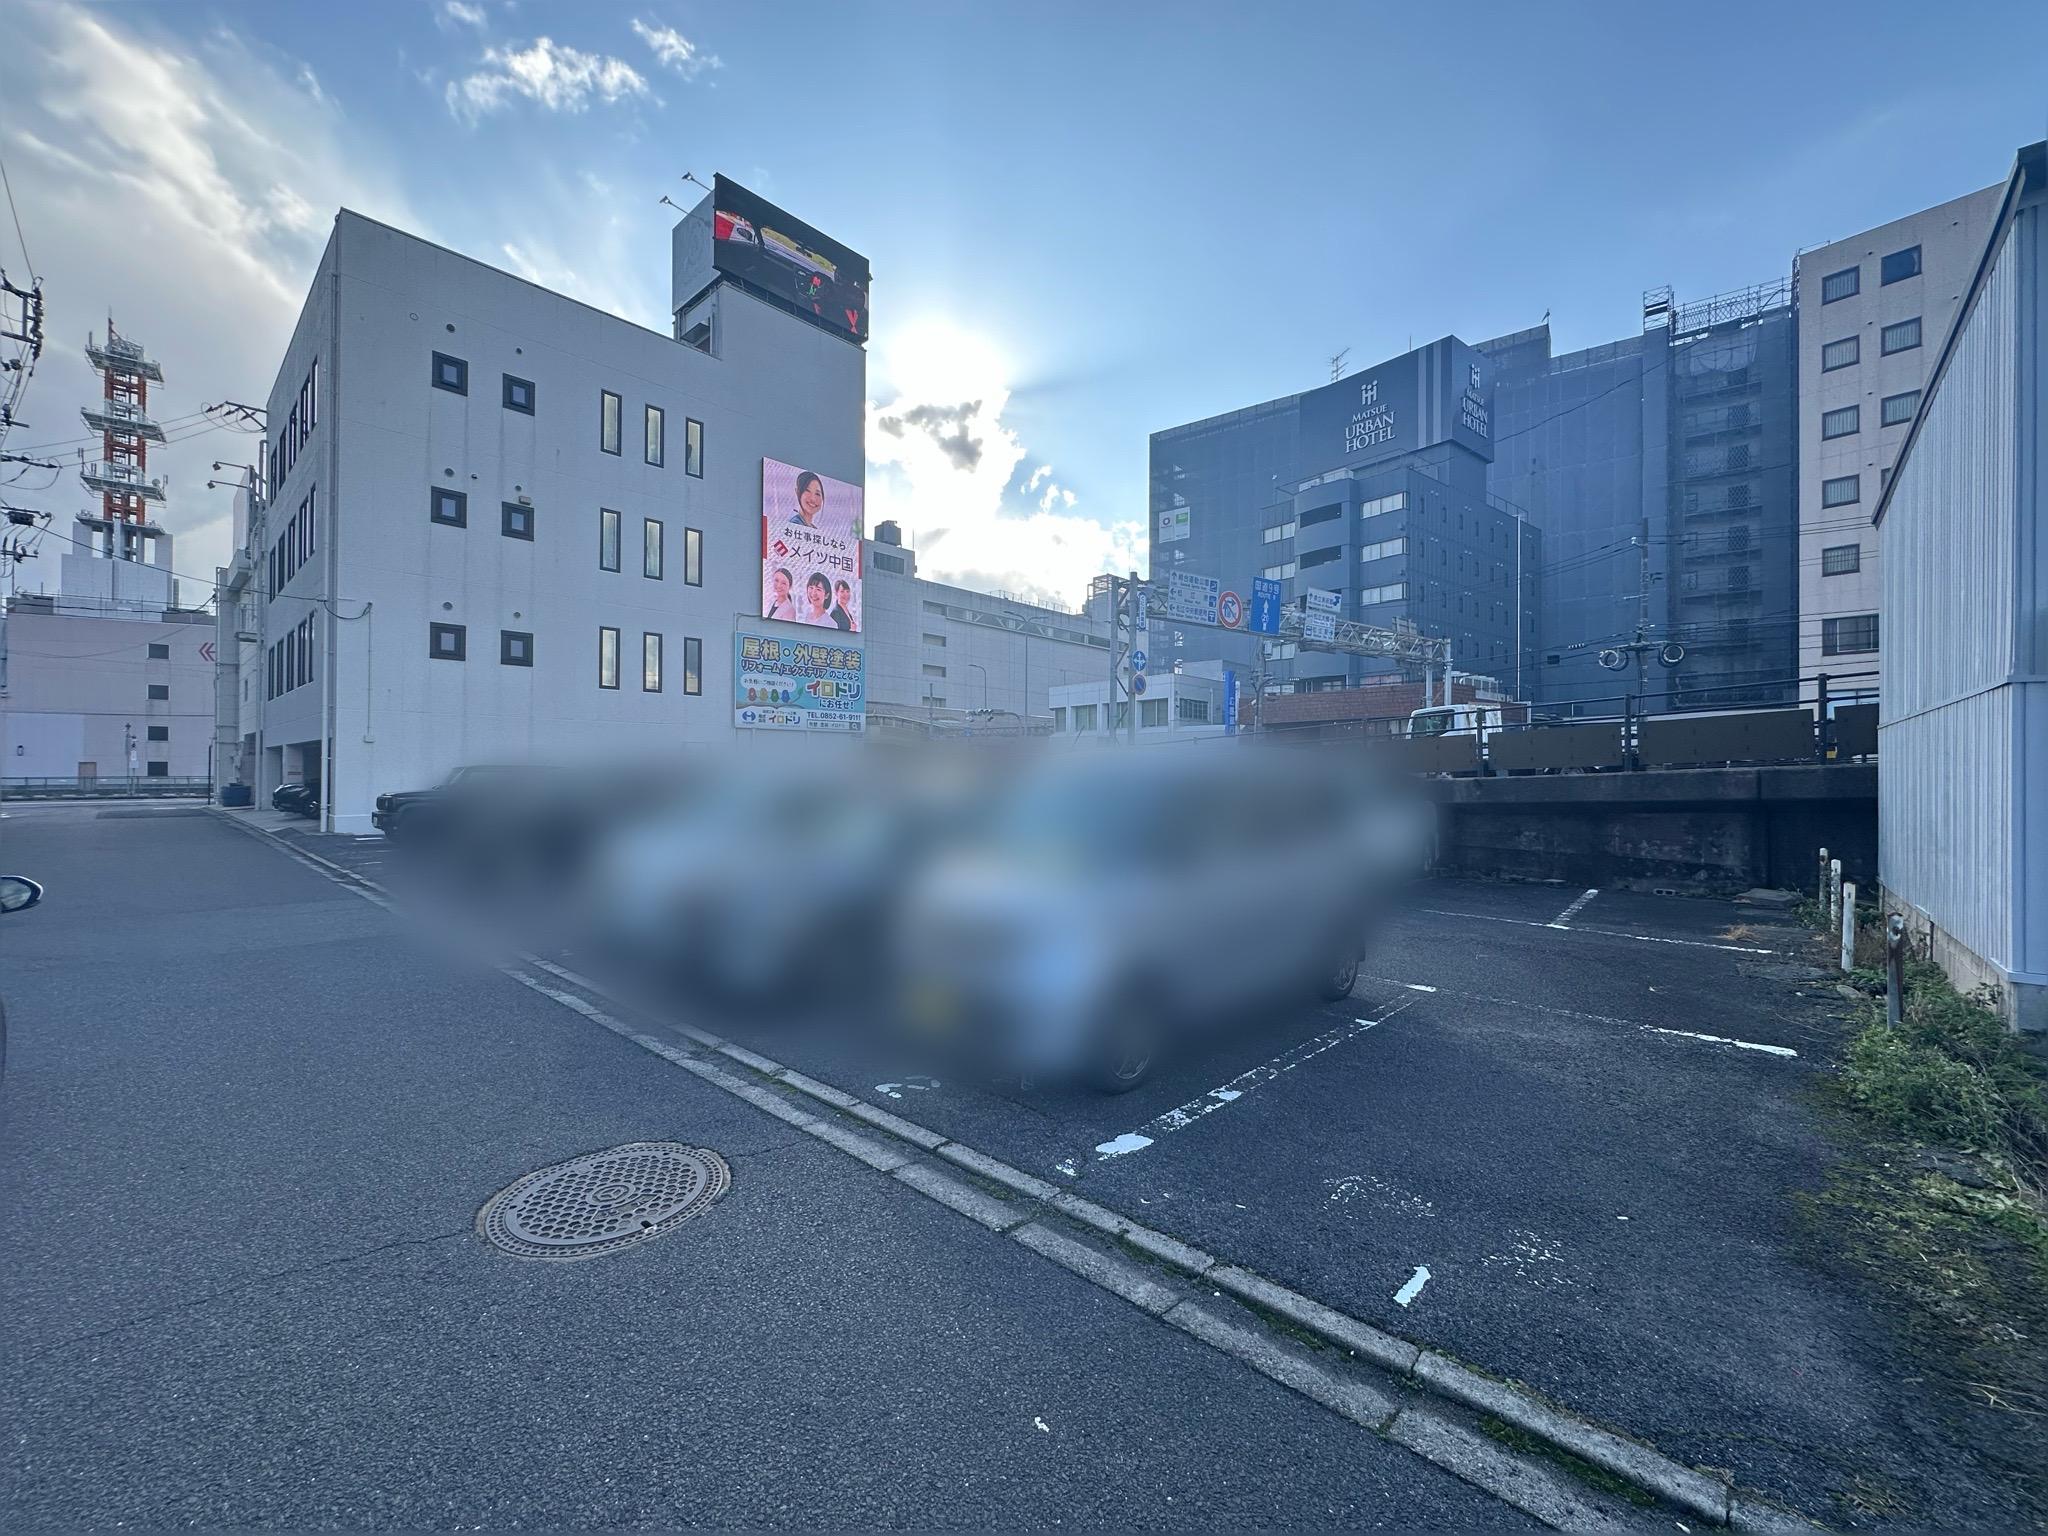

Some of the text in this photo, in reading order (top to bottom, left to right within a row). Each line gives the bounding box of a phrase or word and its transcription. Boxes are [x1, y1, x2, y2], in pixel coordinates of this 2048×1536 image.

[1466, 387, 1485, 405] MATSUE
[1352, 403, 1388, 423] MATSUE
[1462, 397, 1488, 424] URBAN
[1345, 411, 1396, 440] URBAN
[1463, 412, 1488, 439] HOTEL
[1345, 427, 1396, 454] HOTEL
[784, 527, 846, 551] お仕事探しなら
[789, 545, 853, 572] メイツ中国
[741, 637, 861, 671] 屋根・外壁塗装
[829, 671, 860, 681] のことなら
[806, 679, 861, 699] イロドリ
[768, 714, 801, 724] イロドリ
